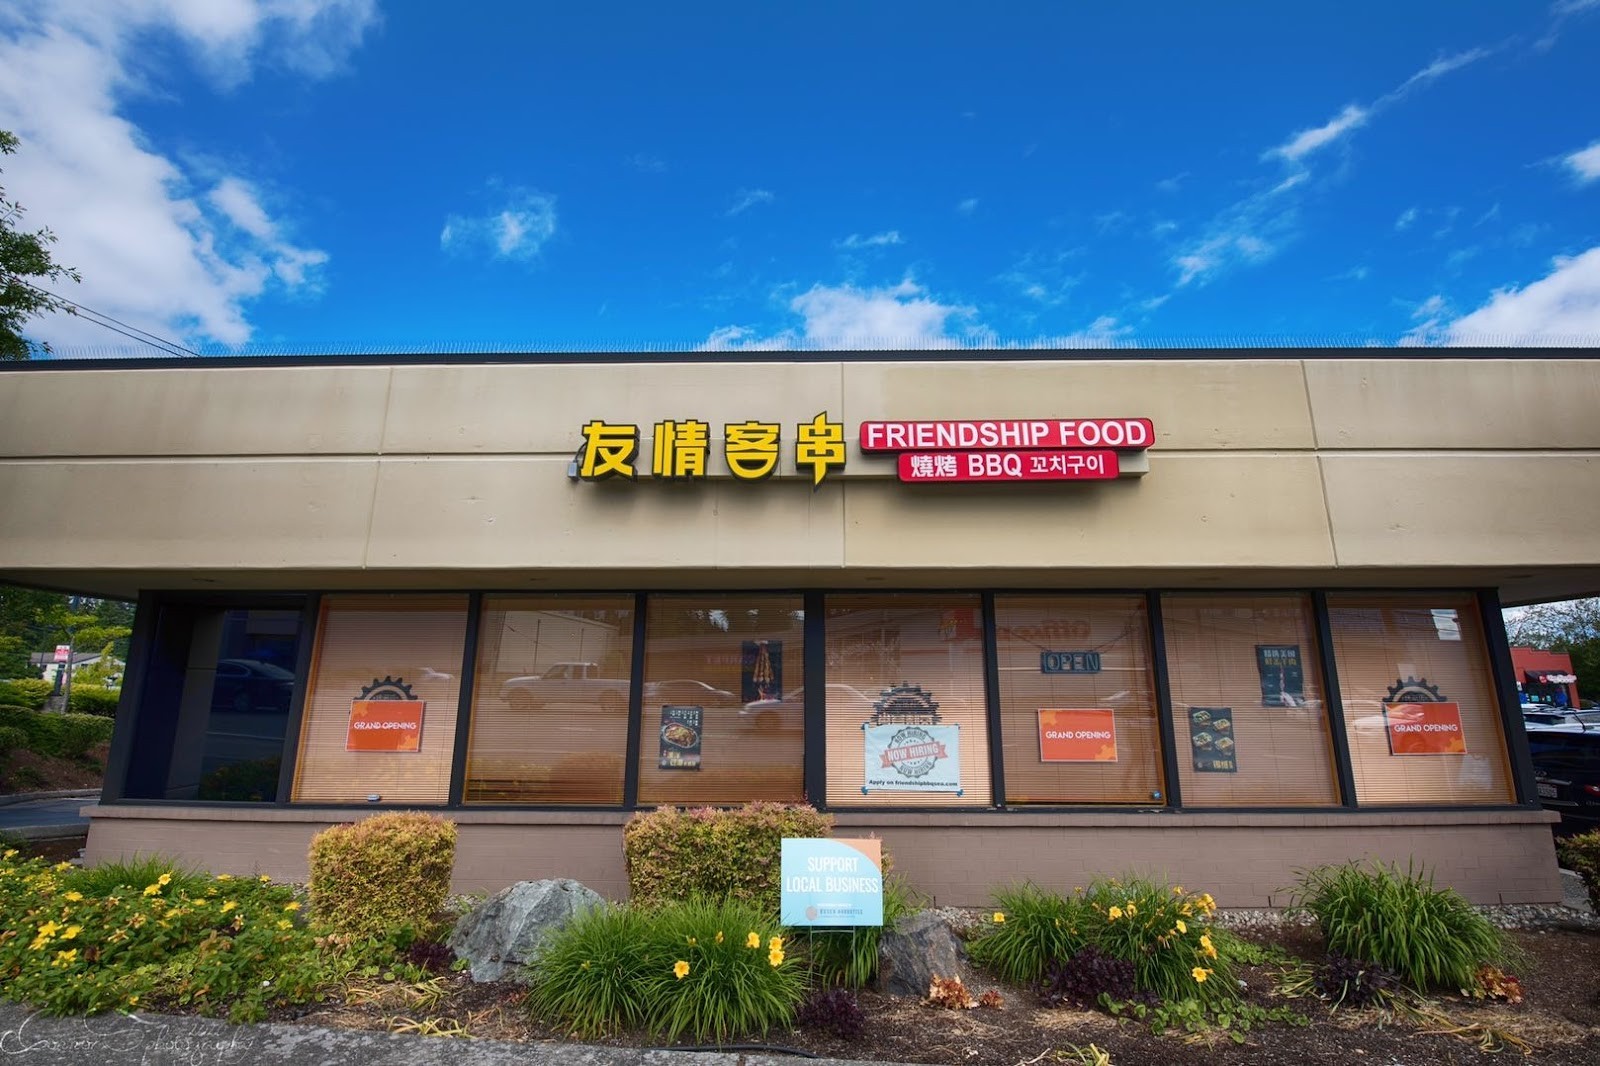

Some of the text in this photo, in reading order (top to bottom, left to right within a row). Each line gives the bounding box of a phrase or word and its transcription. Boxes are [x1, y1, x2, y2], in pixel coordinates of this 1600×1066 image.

[866, 421, 1147, 448] FRIENDSHIP FOOD
[580, 410, 846, 487] 友情客串
[911, 454, 1105, 478] 燒烤 BBQ 꼬치구이
[1046, 653, 1099, 671] OPEN
[353, 720, 417, 731] GRAND OPENING
[1393, 723, 1459, 733] GRAND OPENING
[1045, 730, 1112, 740] GRAND OPENING
[887, 744, 938, 762] NOW HIRING
[868, 779, 885, 787] Apply
[807, 856, 860, 873] SUPPORT
[786, 876, 879, 894] LOCAL BUSINESS
